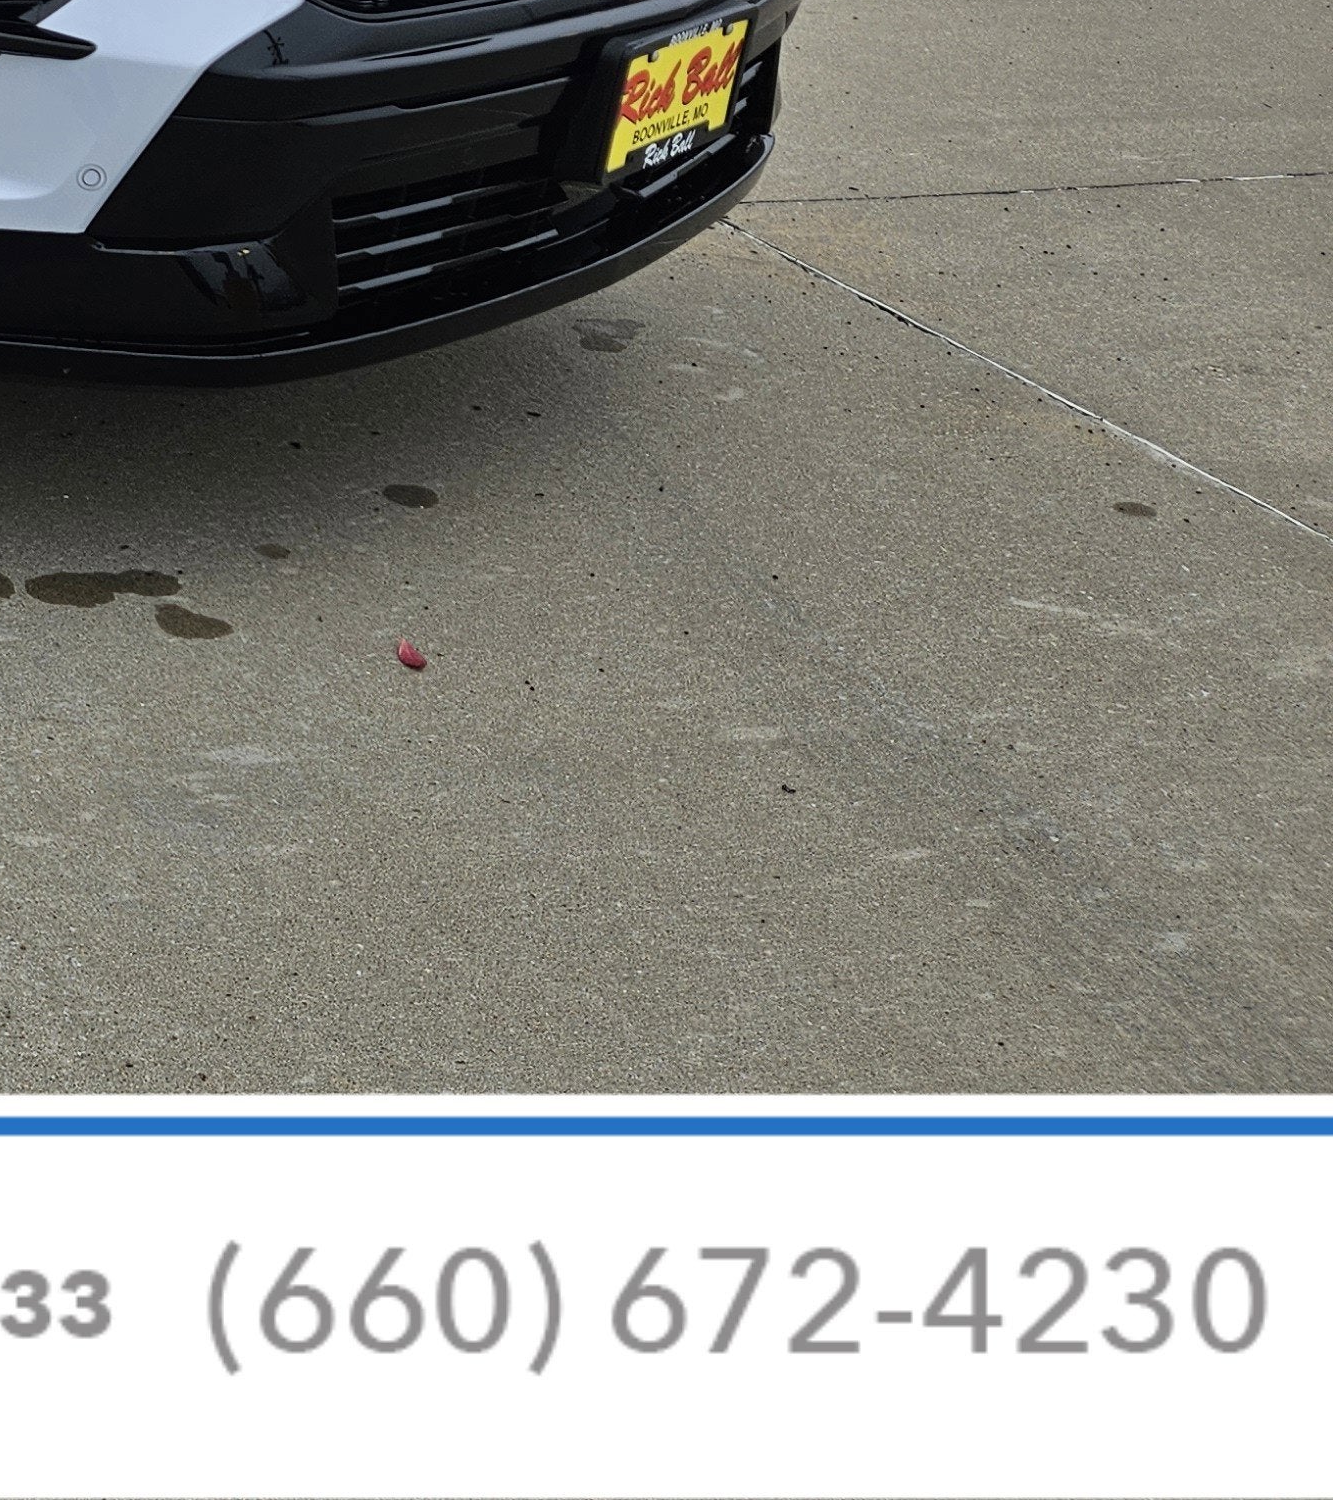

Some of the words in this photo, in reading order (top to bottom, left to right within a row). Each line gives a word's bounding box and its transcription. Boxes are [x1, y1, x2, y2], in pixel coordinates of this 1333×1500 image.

[620, 59, 682, 124] Rick
[682, 38, 745, 105] Ball
[632, 110, 691, 145] BOONVILLE,
[693, 103, 709, 120] MO
[643, 138, 671, 169] Rick
[670, 129, 697, 157] Ball
